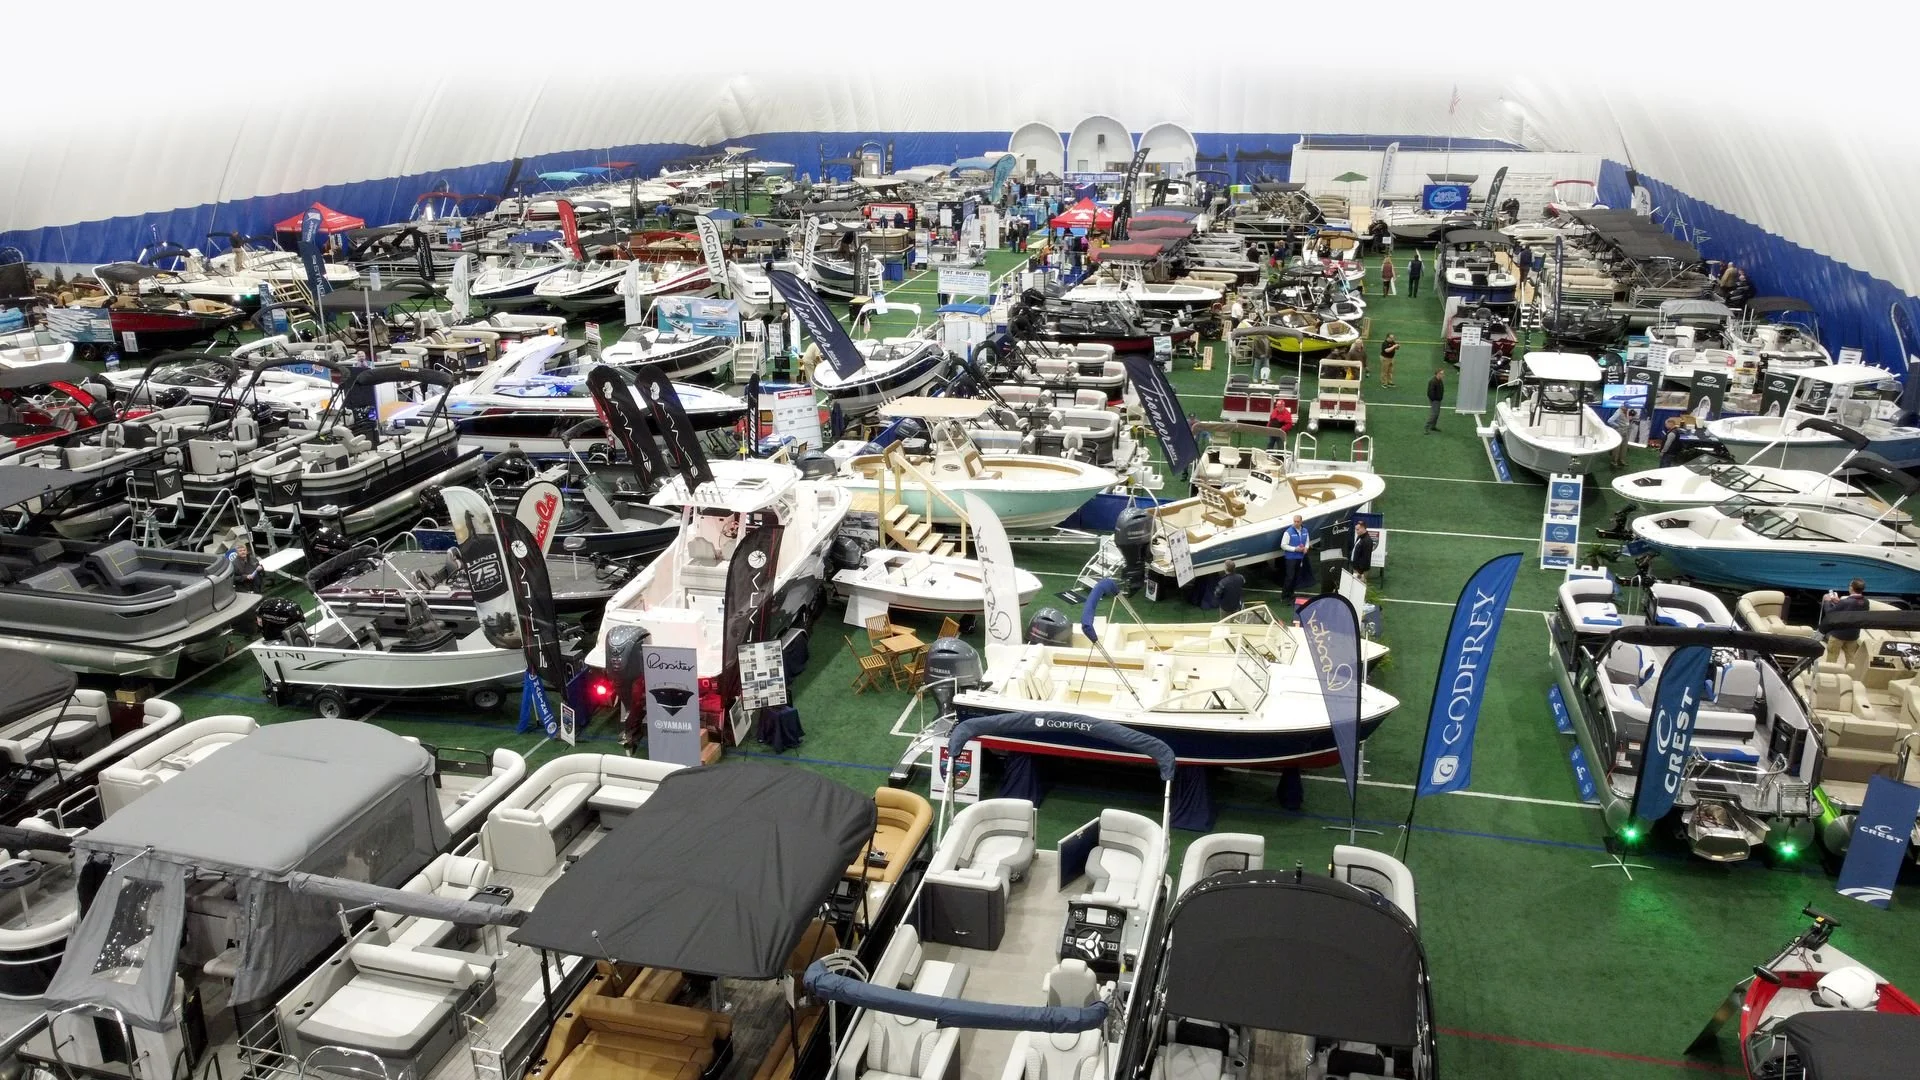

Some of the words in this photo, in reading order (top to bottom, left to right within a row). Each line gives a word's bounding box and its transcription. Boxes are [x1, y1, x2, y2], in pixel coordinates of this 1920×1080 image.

[701, 221, 724, 279] INGENITY
[787, 278, 834, 350] Pioneer
[1138, 364, 1177, 443] Pioneer
[466, 552, 497, 568] LUND
[471, 563, 497, 582] 75
[266, 651, 306, 661] LUND
[646, 652, 695, 672] Rossiter
[1442, 587, 1496, 745] GODFREY
[663, 720, 692, 730] YAMAHA
[1046, 719, 1093, 732] GODFREY
[1664, 686, 1693, 794] CREST
[1860, 826, 1903, 844] CREST
